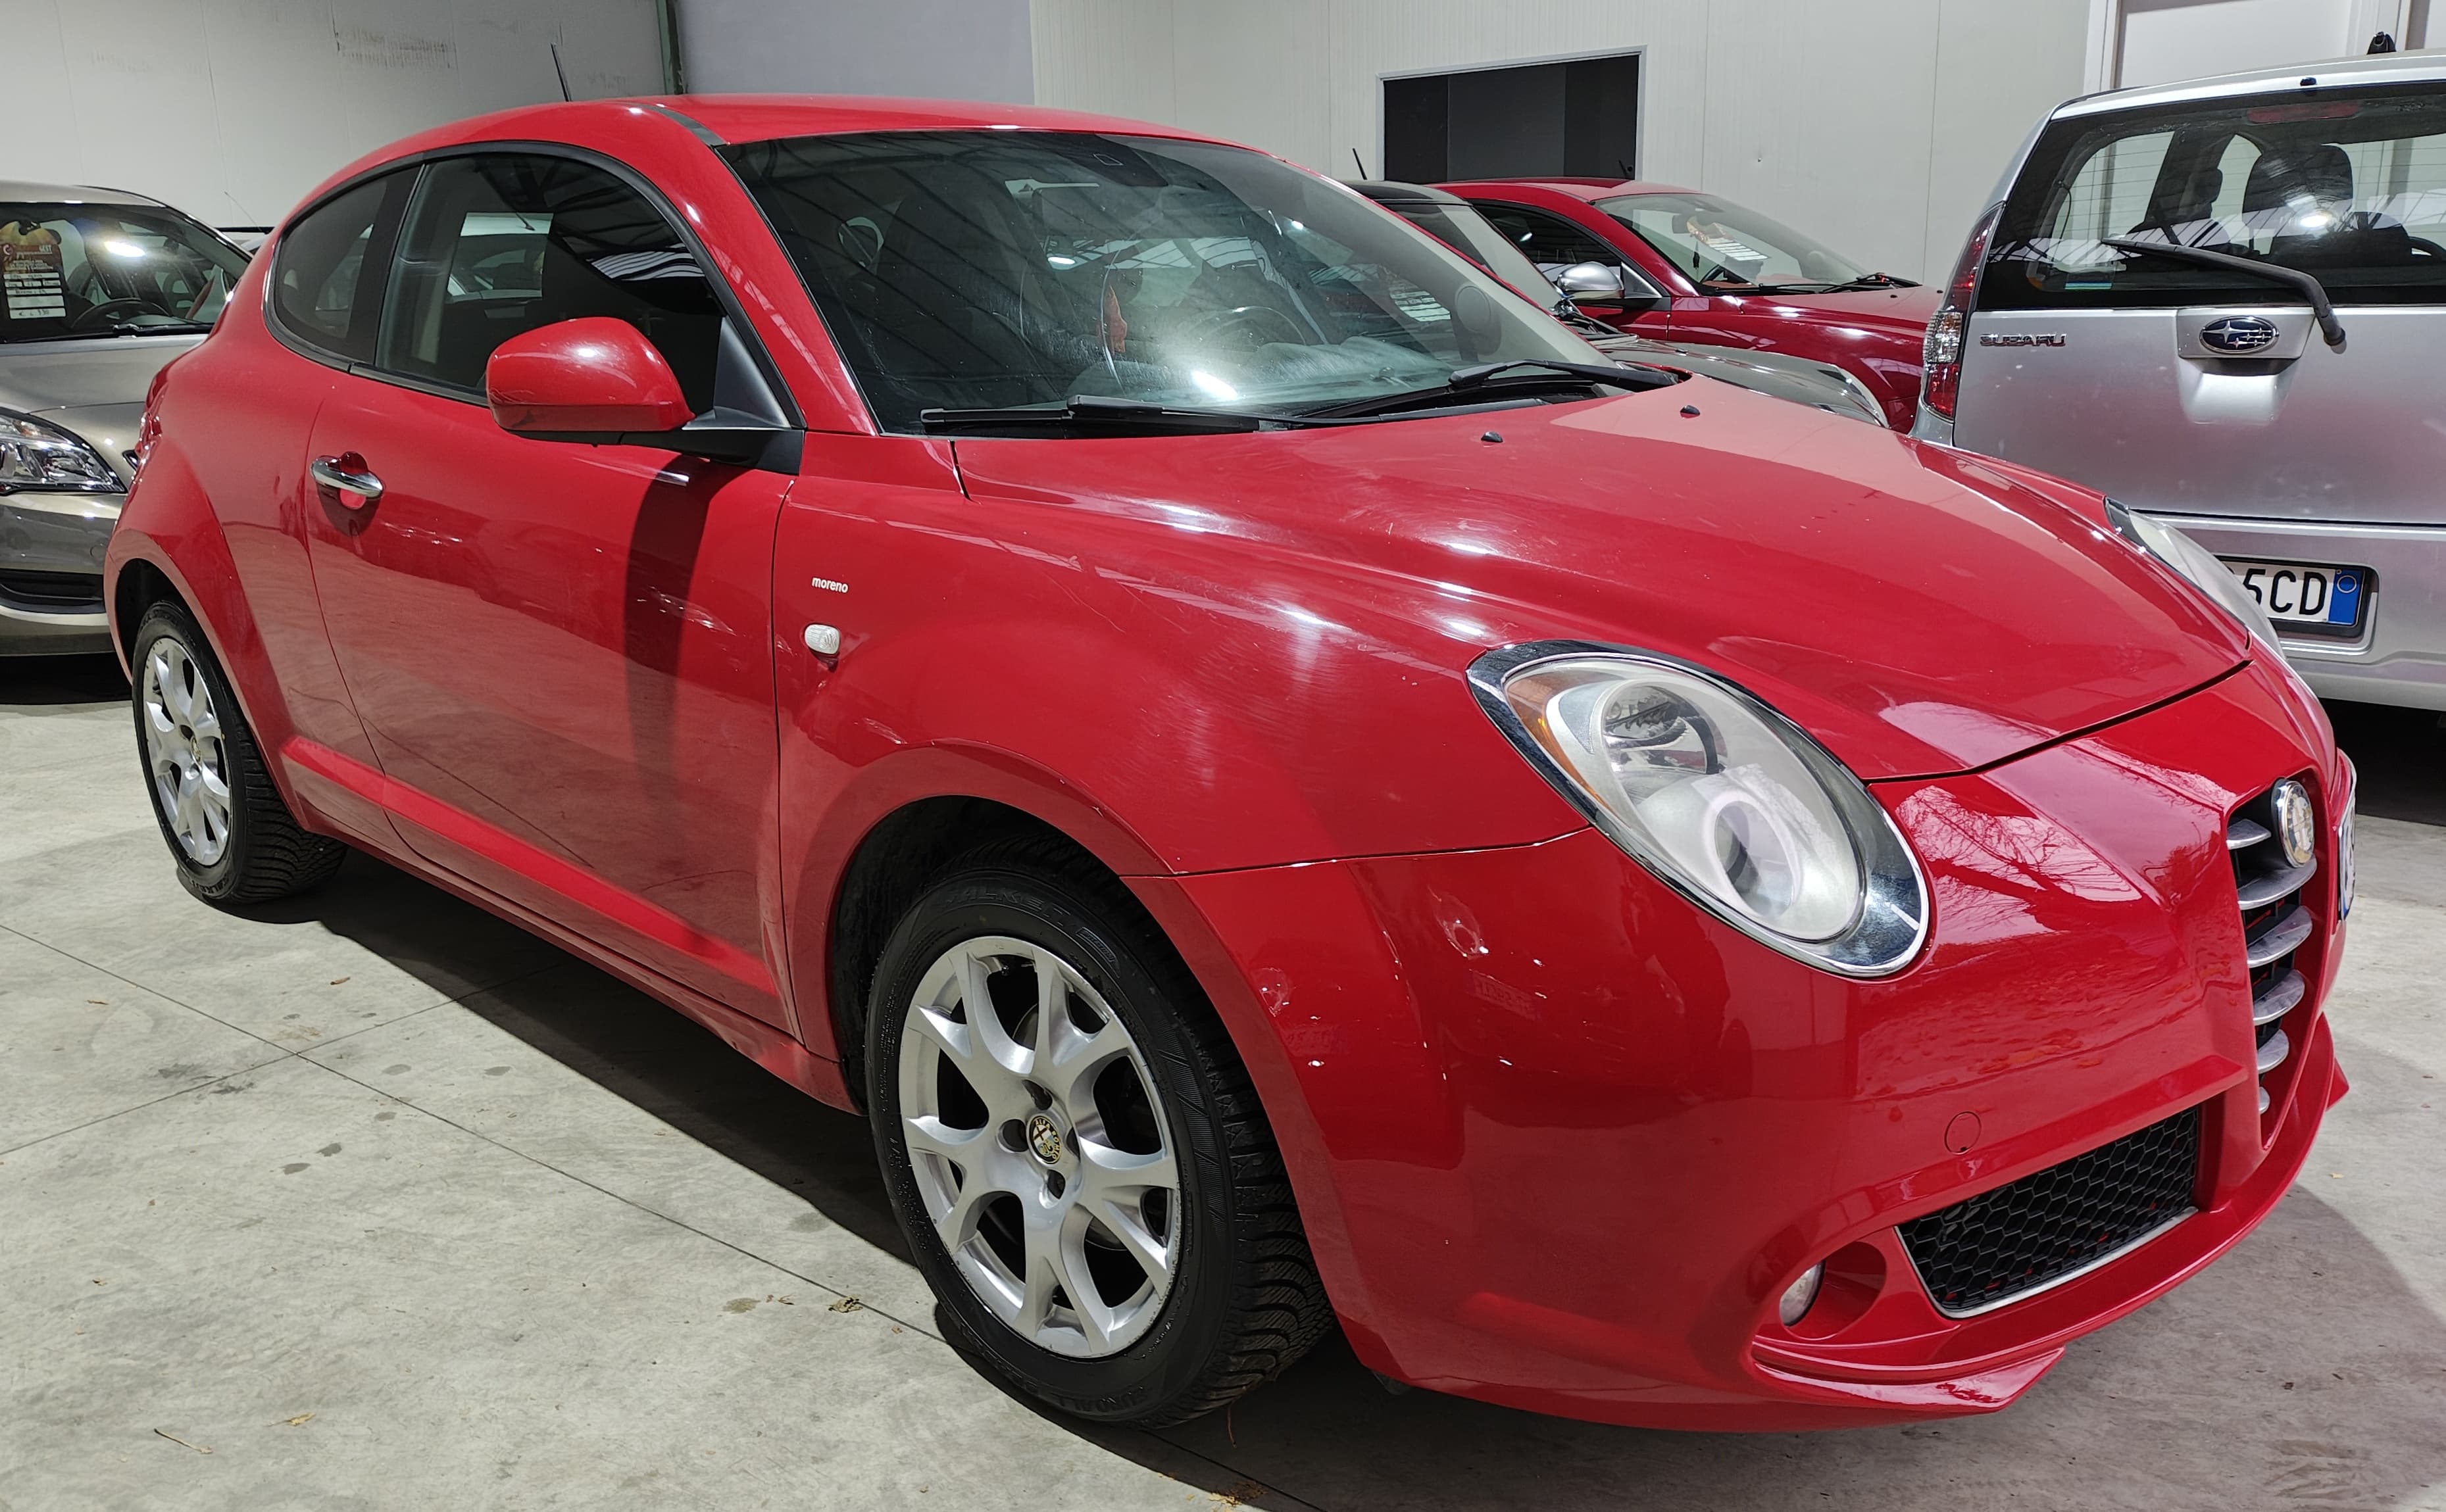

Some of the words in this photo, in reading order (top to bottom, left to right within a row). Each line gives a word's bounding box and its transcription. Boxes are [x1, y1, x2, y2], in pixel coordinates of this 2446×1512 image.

[1980, 333, 2066, 347] SUBARU
[811, 577, 849, 593] moreno
[2227, 567, 2327, 616] 5CD
